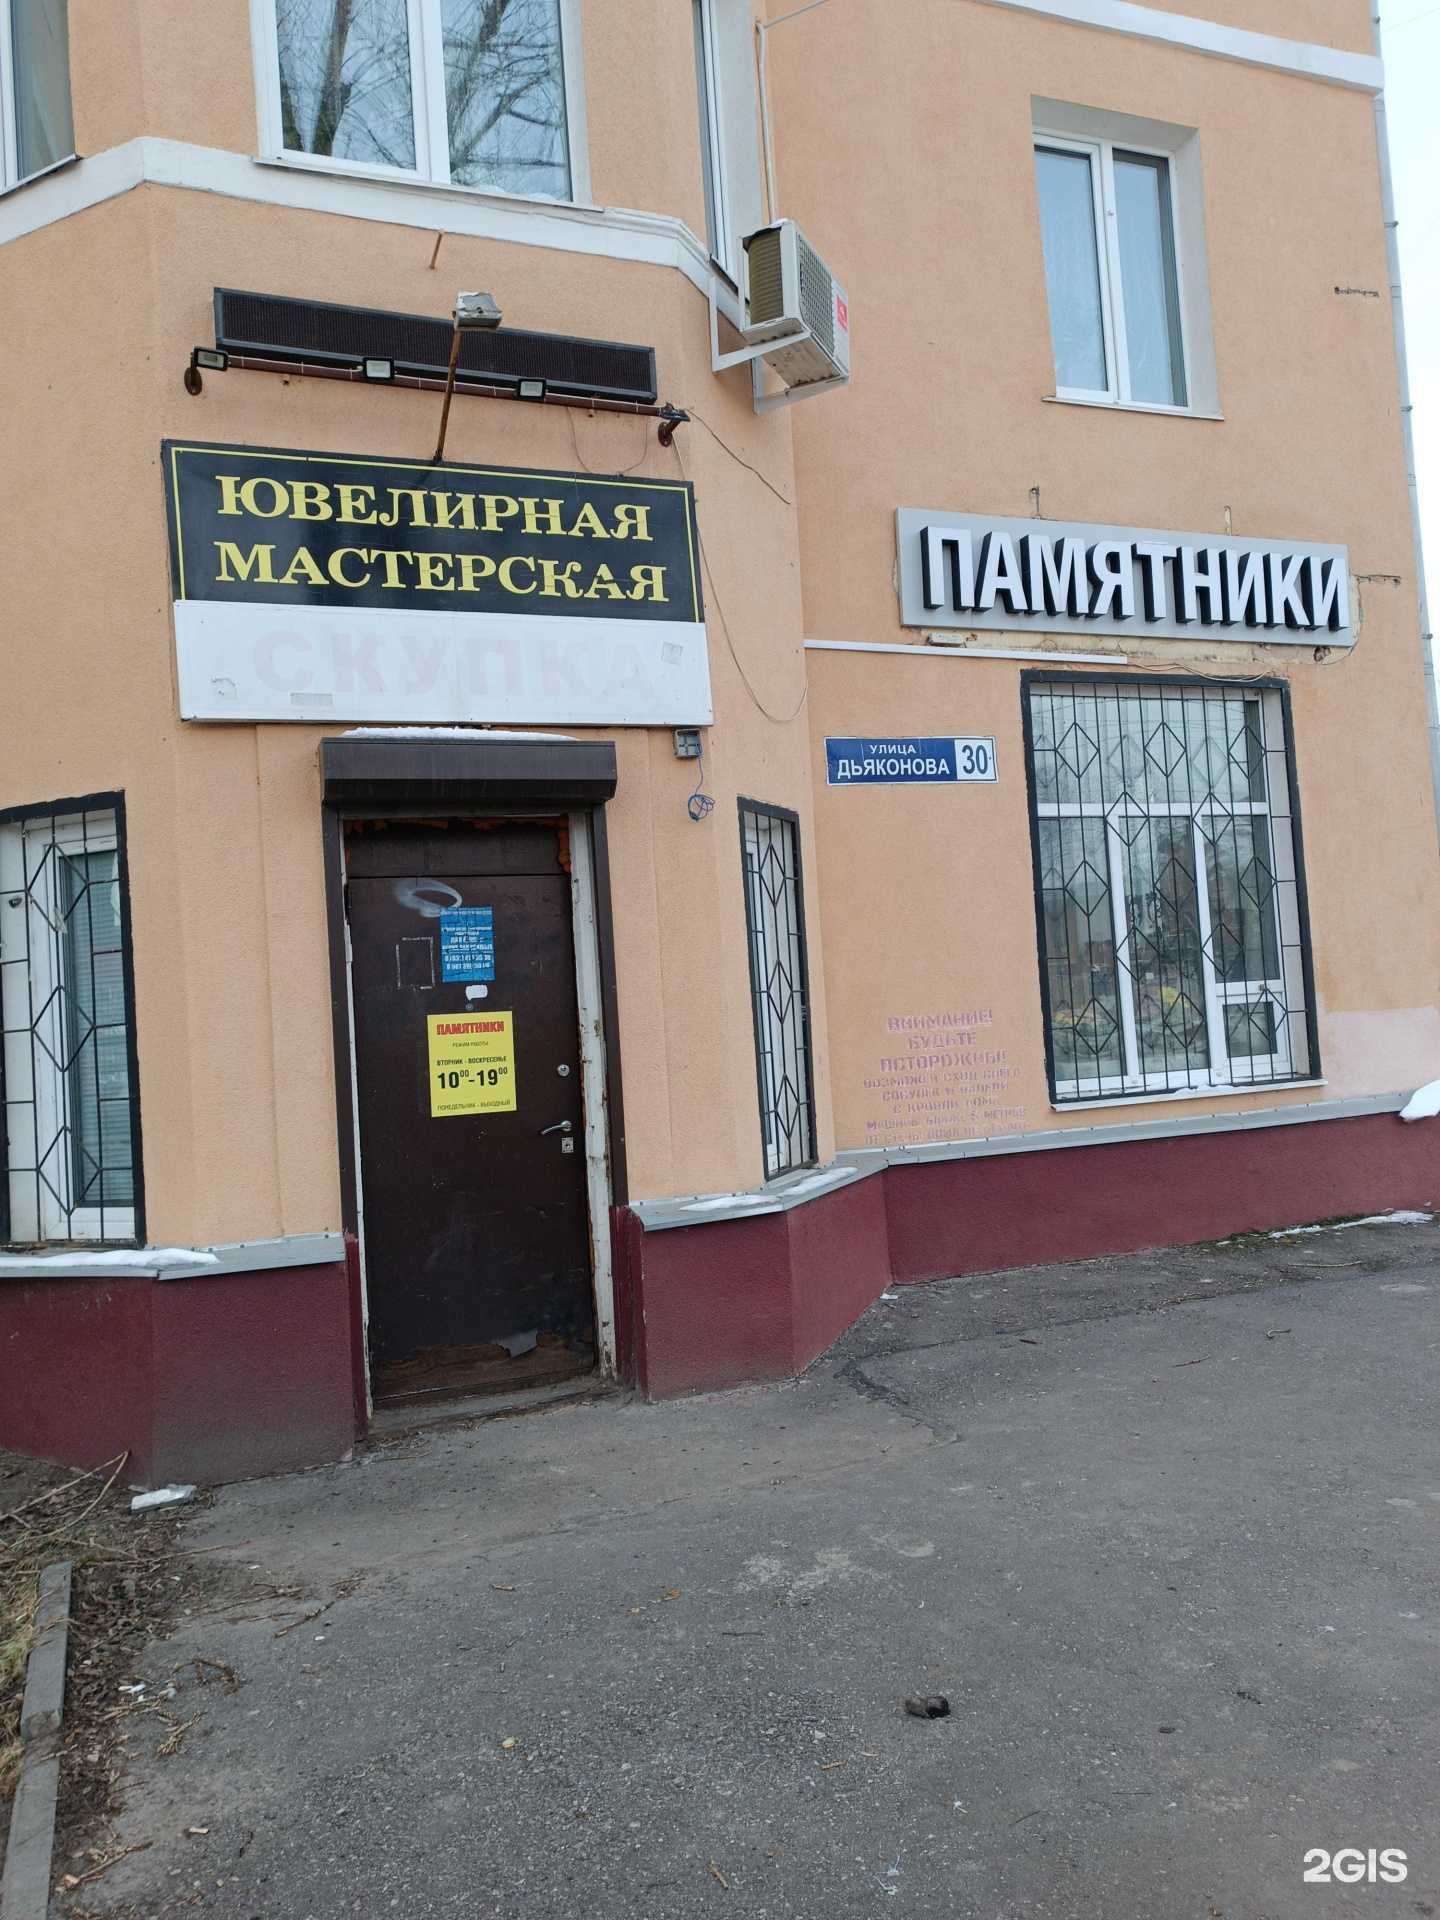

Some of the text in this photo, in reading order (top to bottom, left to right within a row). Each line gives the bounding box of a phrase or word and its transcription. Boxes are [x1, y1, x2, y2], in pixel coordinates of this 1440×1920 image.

[214, 475, 655, 541] ЮВЕЛИРНАЯ
[213, 541, 670, 602] МАСТЕРСКАЯ
[920, 526, 1350, 631] ПАМЯТНИКИ
[253, 629, 656, 701] СКУПКА
[837, 758, 950, 780] ДЬЯКОНОВА
[870, 744, 917, 756] УЛИЦА
[962, 744, 988, 775] 30
[436, 1021, 505, 1035] ПАМЯТНИКИ
